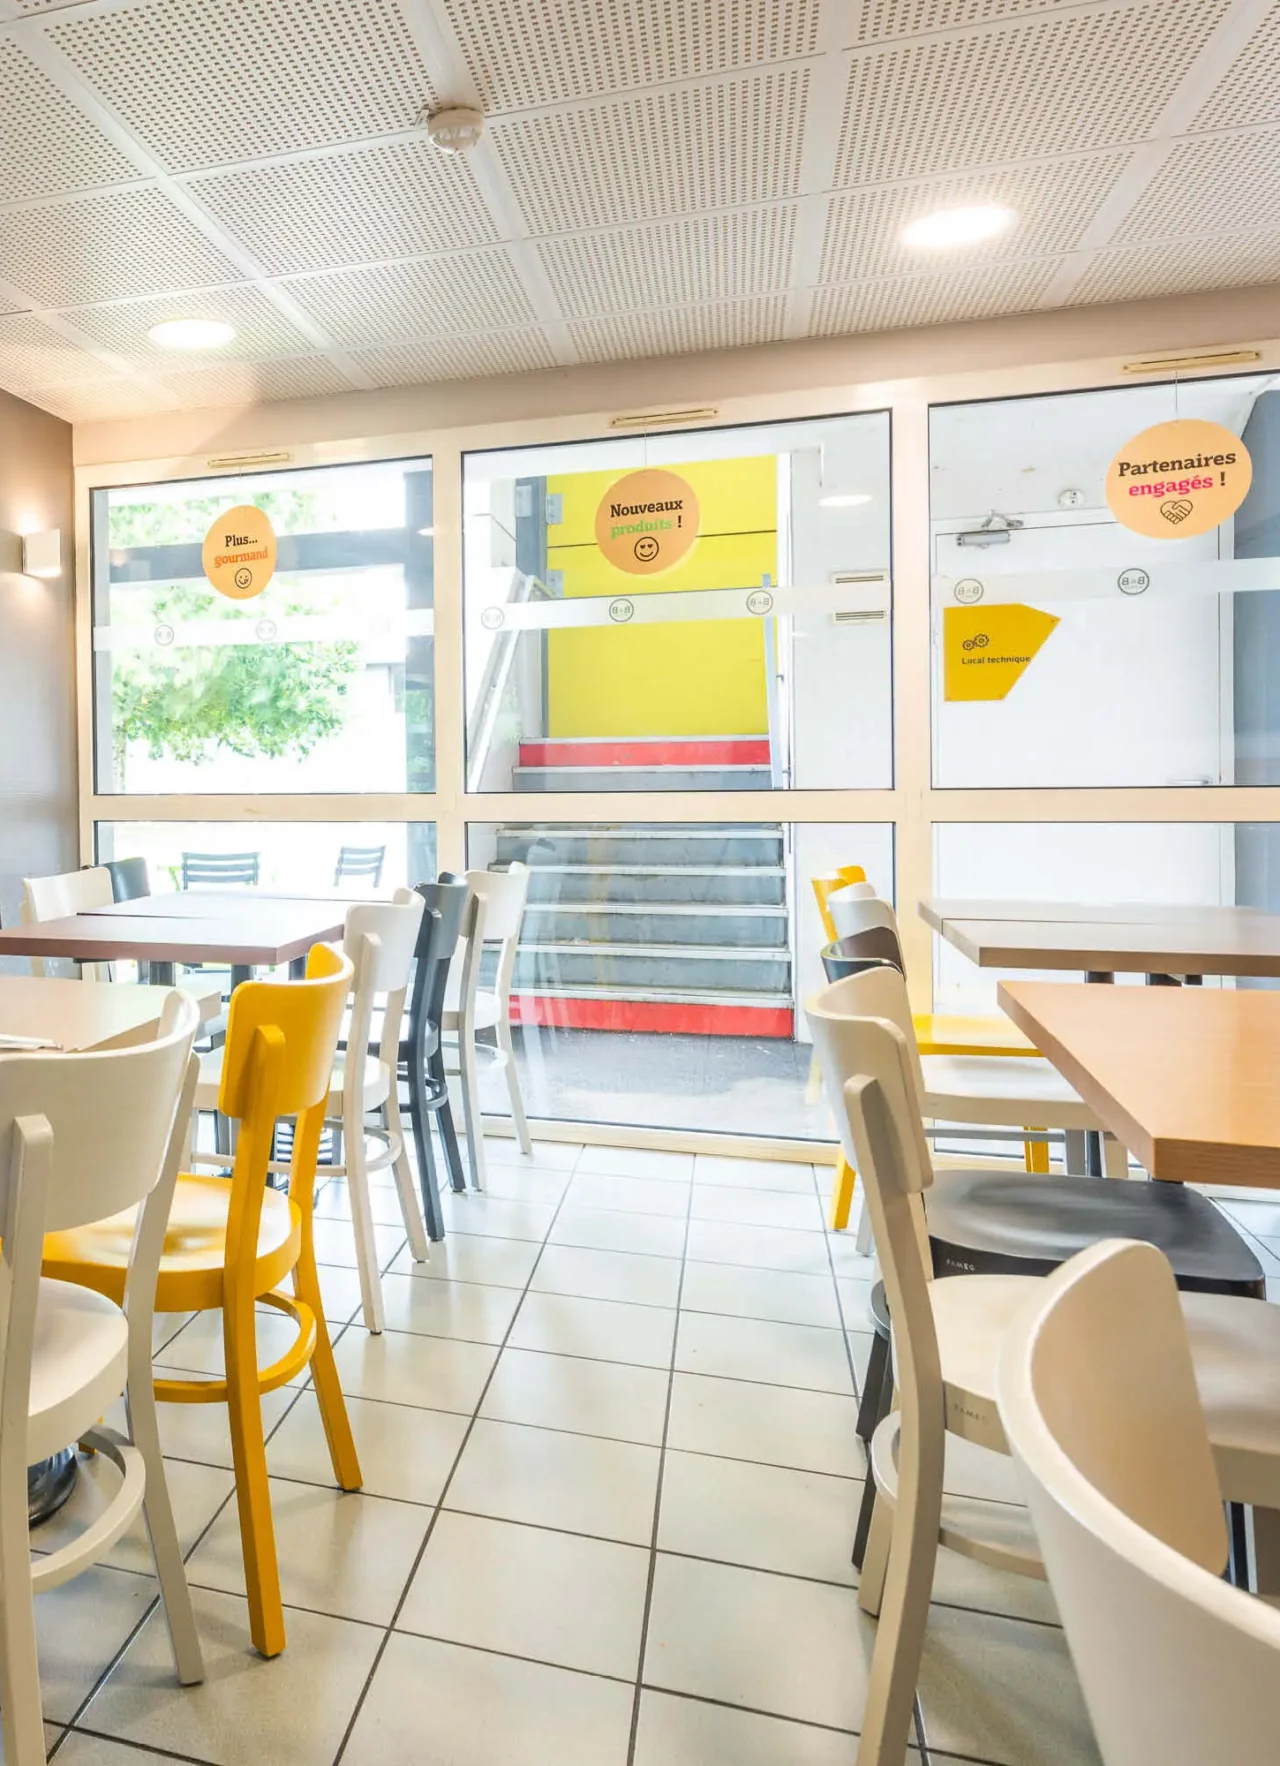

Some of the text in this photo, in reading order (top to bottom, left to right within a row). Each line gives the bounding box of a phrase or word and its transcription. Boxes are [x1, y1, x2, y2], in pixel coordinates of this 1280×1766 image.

[1118, 452, 1237, 477] Partenaires
[1128, 471, 1226, 498] engagés !
[610, 500, 683, 518] Nouveaux
[611, 514, 682, 540] produits !
[224, 534, 258, 548] Plus...
[214, 546, 268, 569] gourmand
[962, 655, 1031, 665] Local technique
